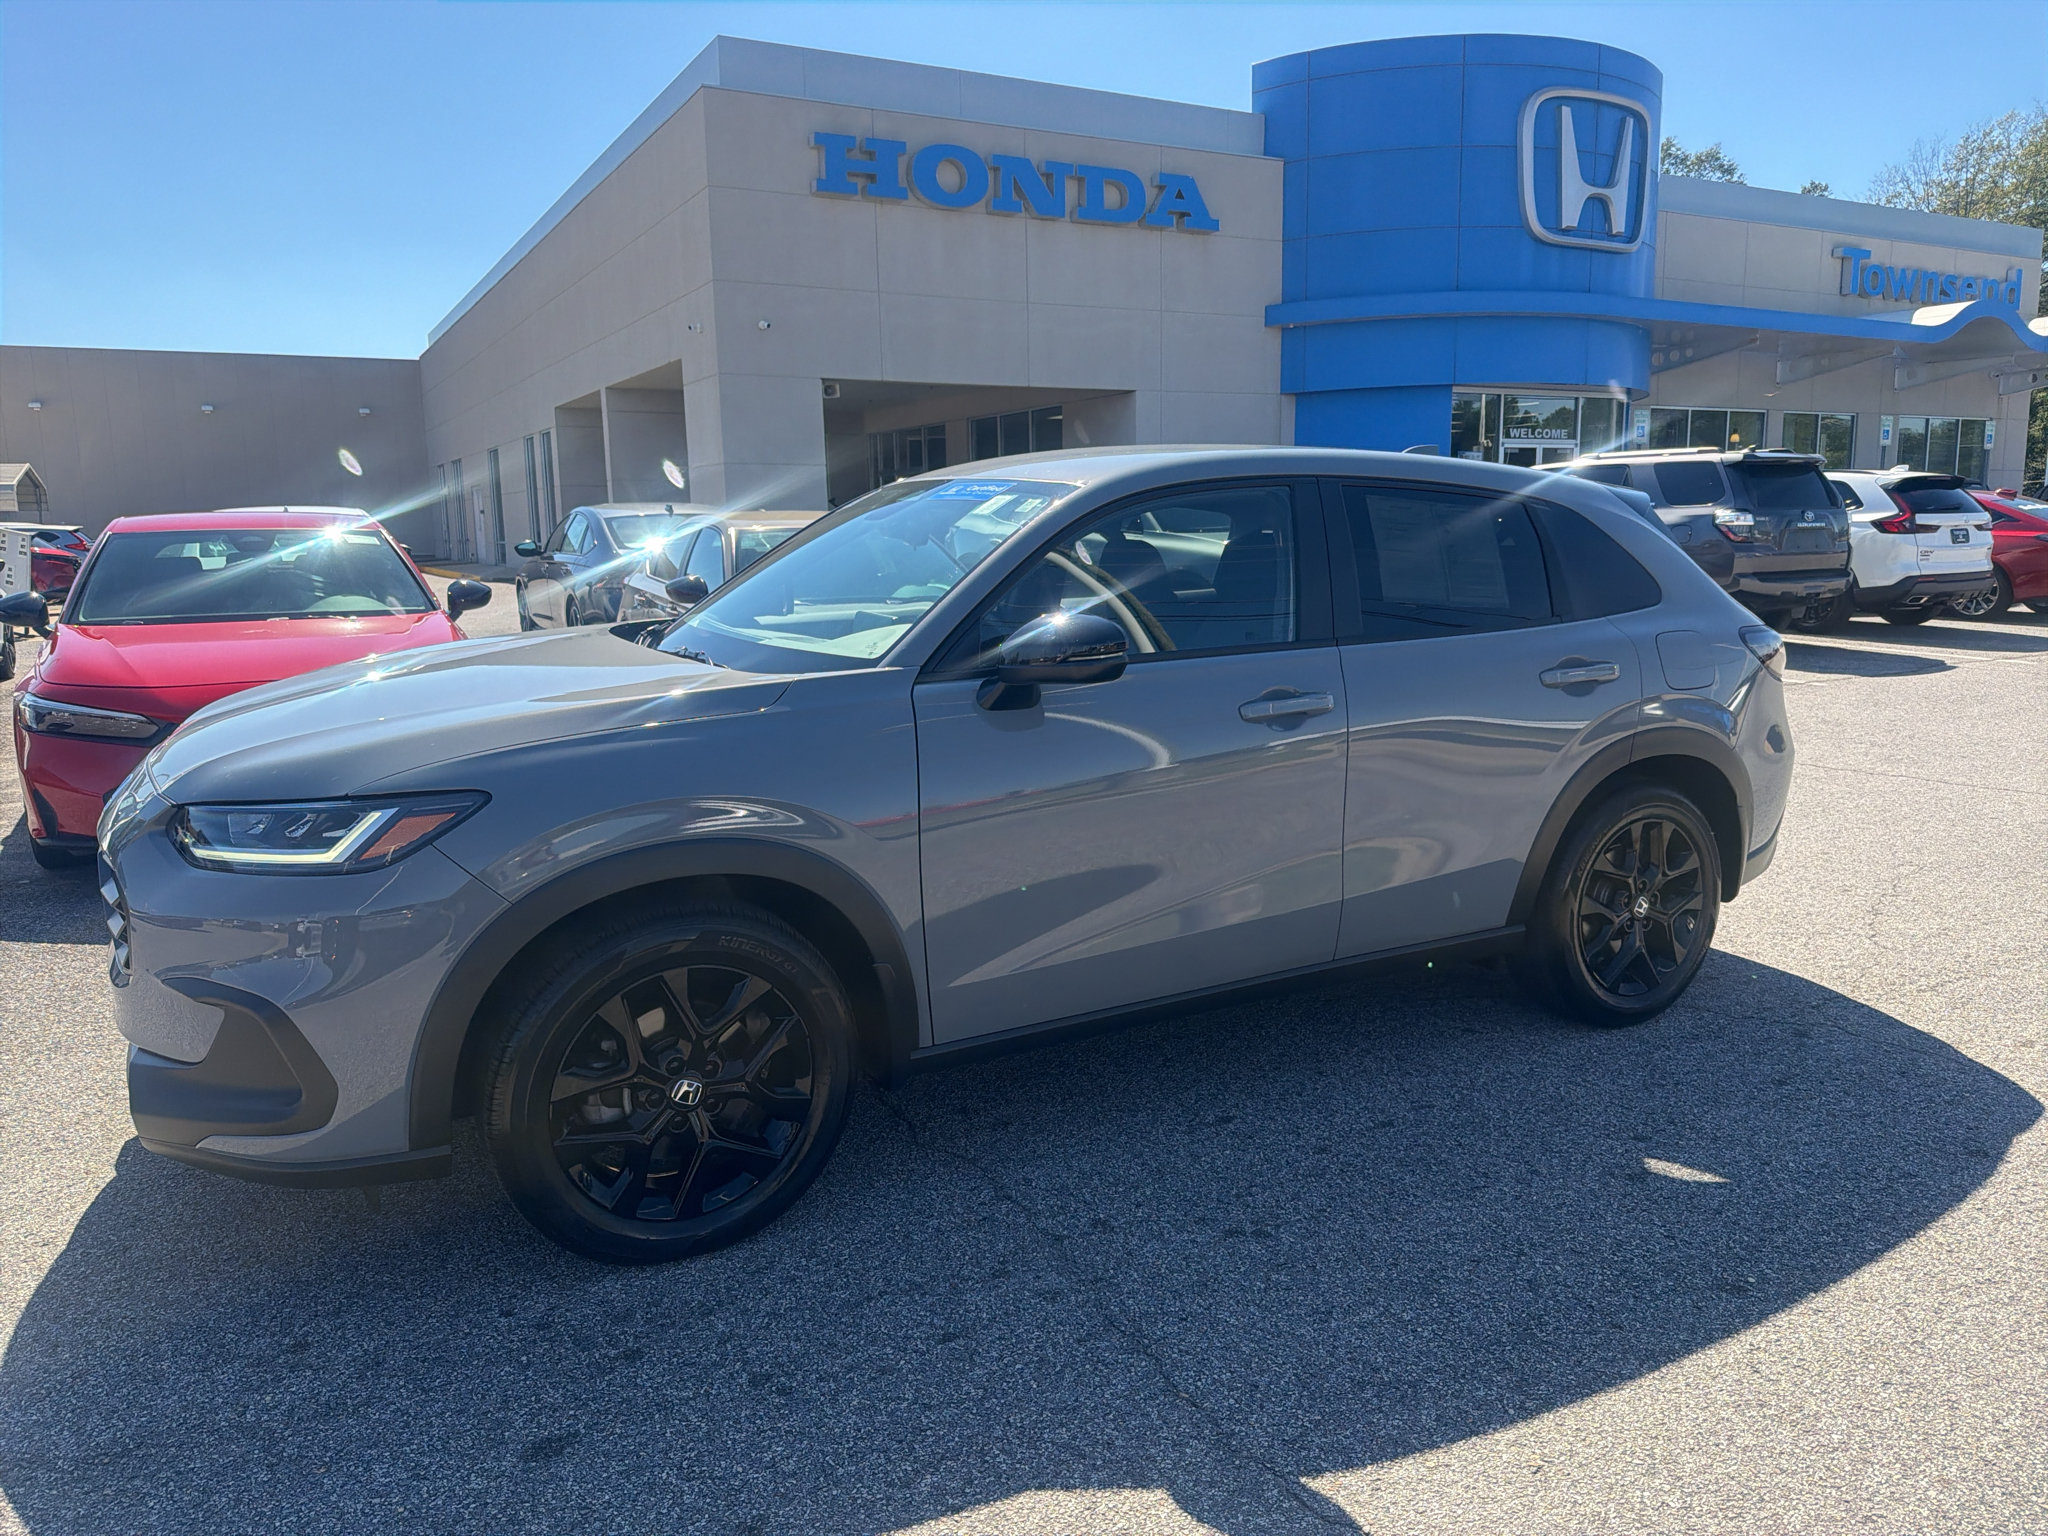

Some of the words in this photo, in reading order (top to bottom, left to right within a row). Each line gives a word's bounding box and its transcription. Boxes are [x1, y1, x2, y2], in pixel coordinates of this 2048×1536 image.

[809, 131, 1220, 233] HONDA
[1834, 246, 2023, 311] Townsend
[1509, 427, 1569, 439] WELCOME
